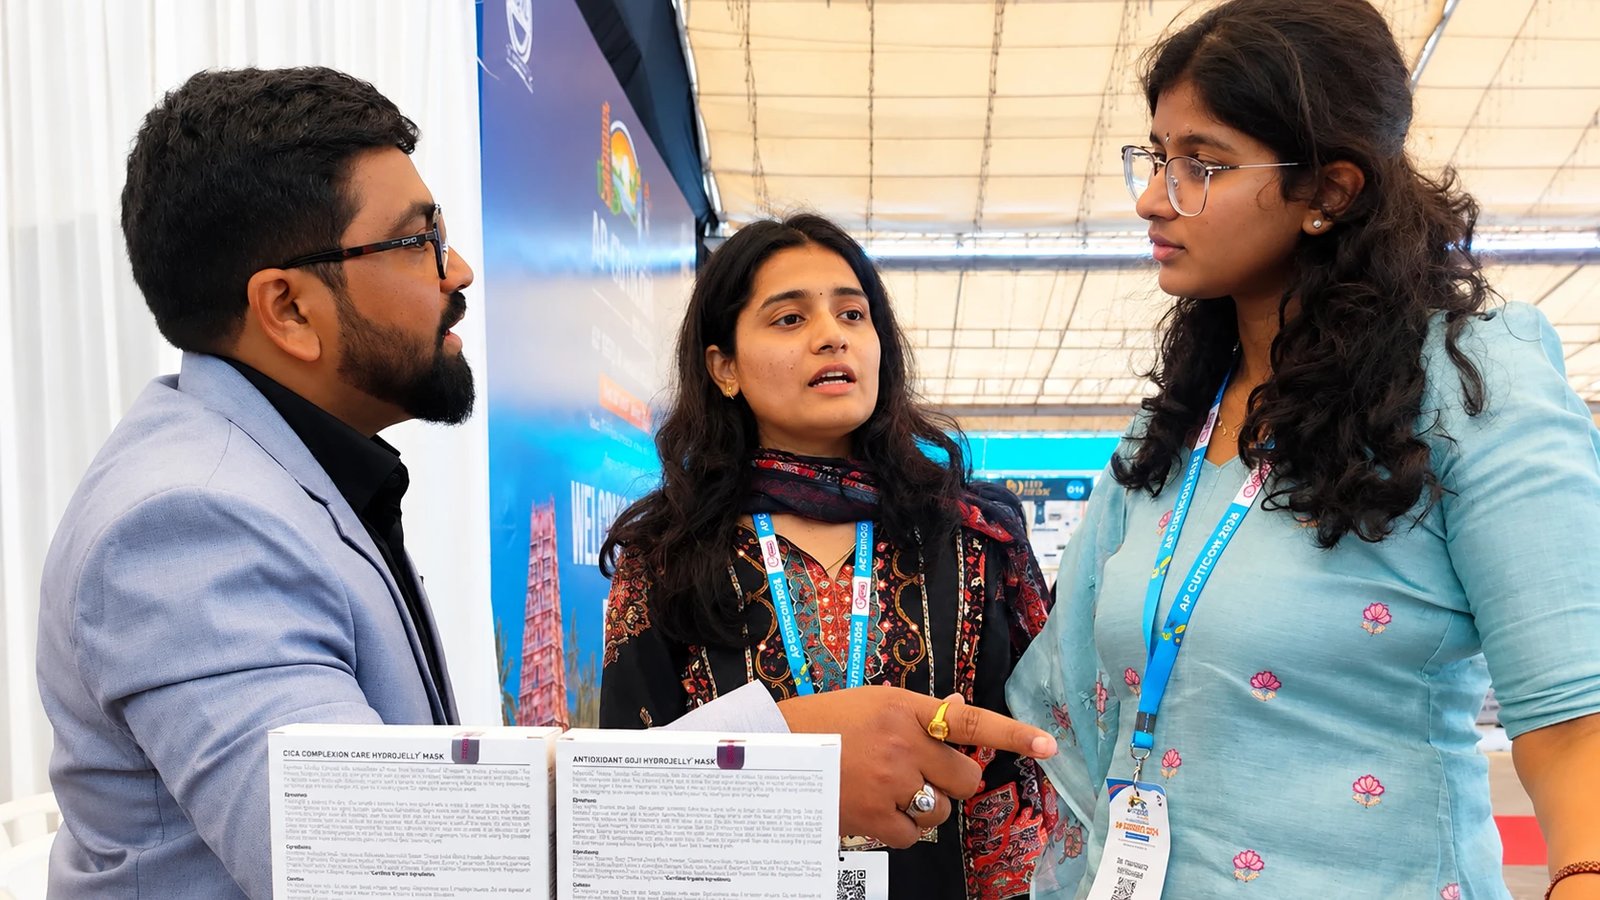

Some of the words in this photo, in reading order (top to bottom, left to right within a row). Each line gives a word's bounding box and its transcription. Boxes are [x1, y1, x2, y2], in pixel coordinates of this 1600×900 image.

[1179, 594, 1191, 612] AP
[283, 749, 300, 757] CICA
[301, 750, 349, 758] COMPLEXION
[351, 751, 370, 759] CARE
